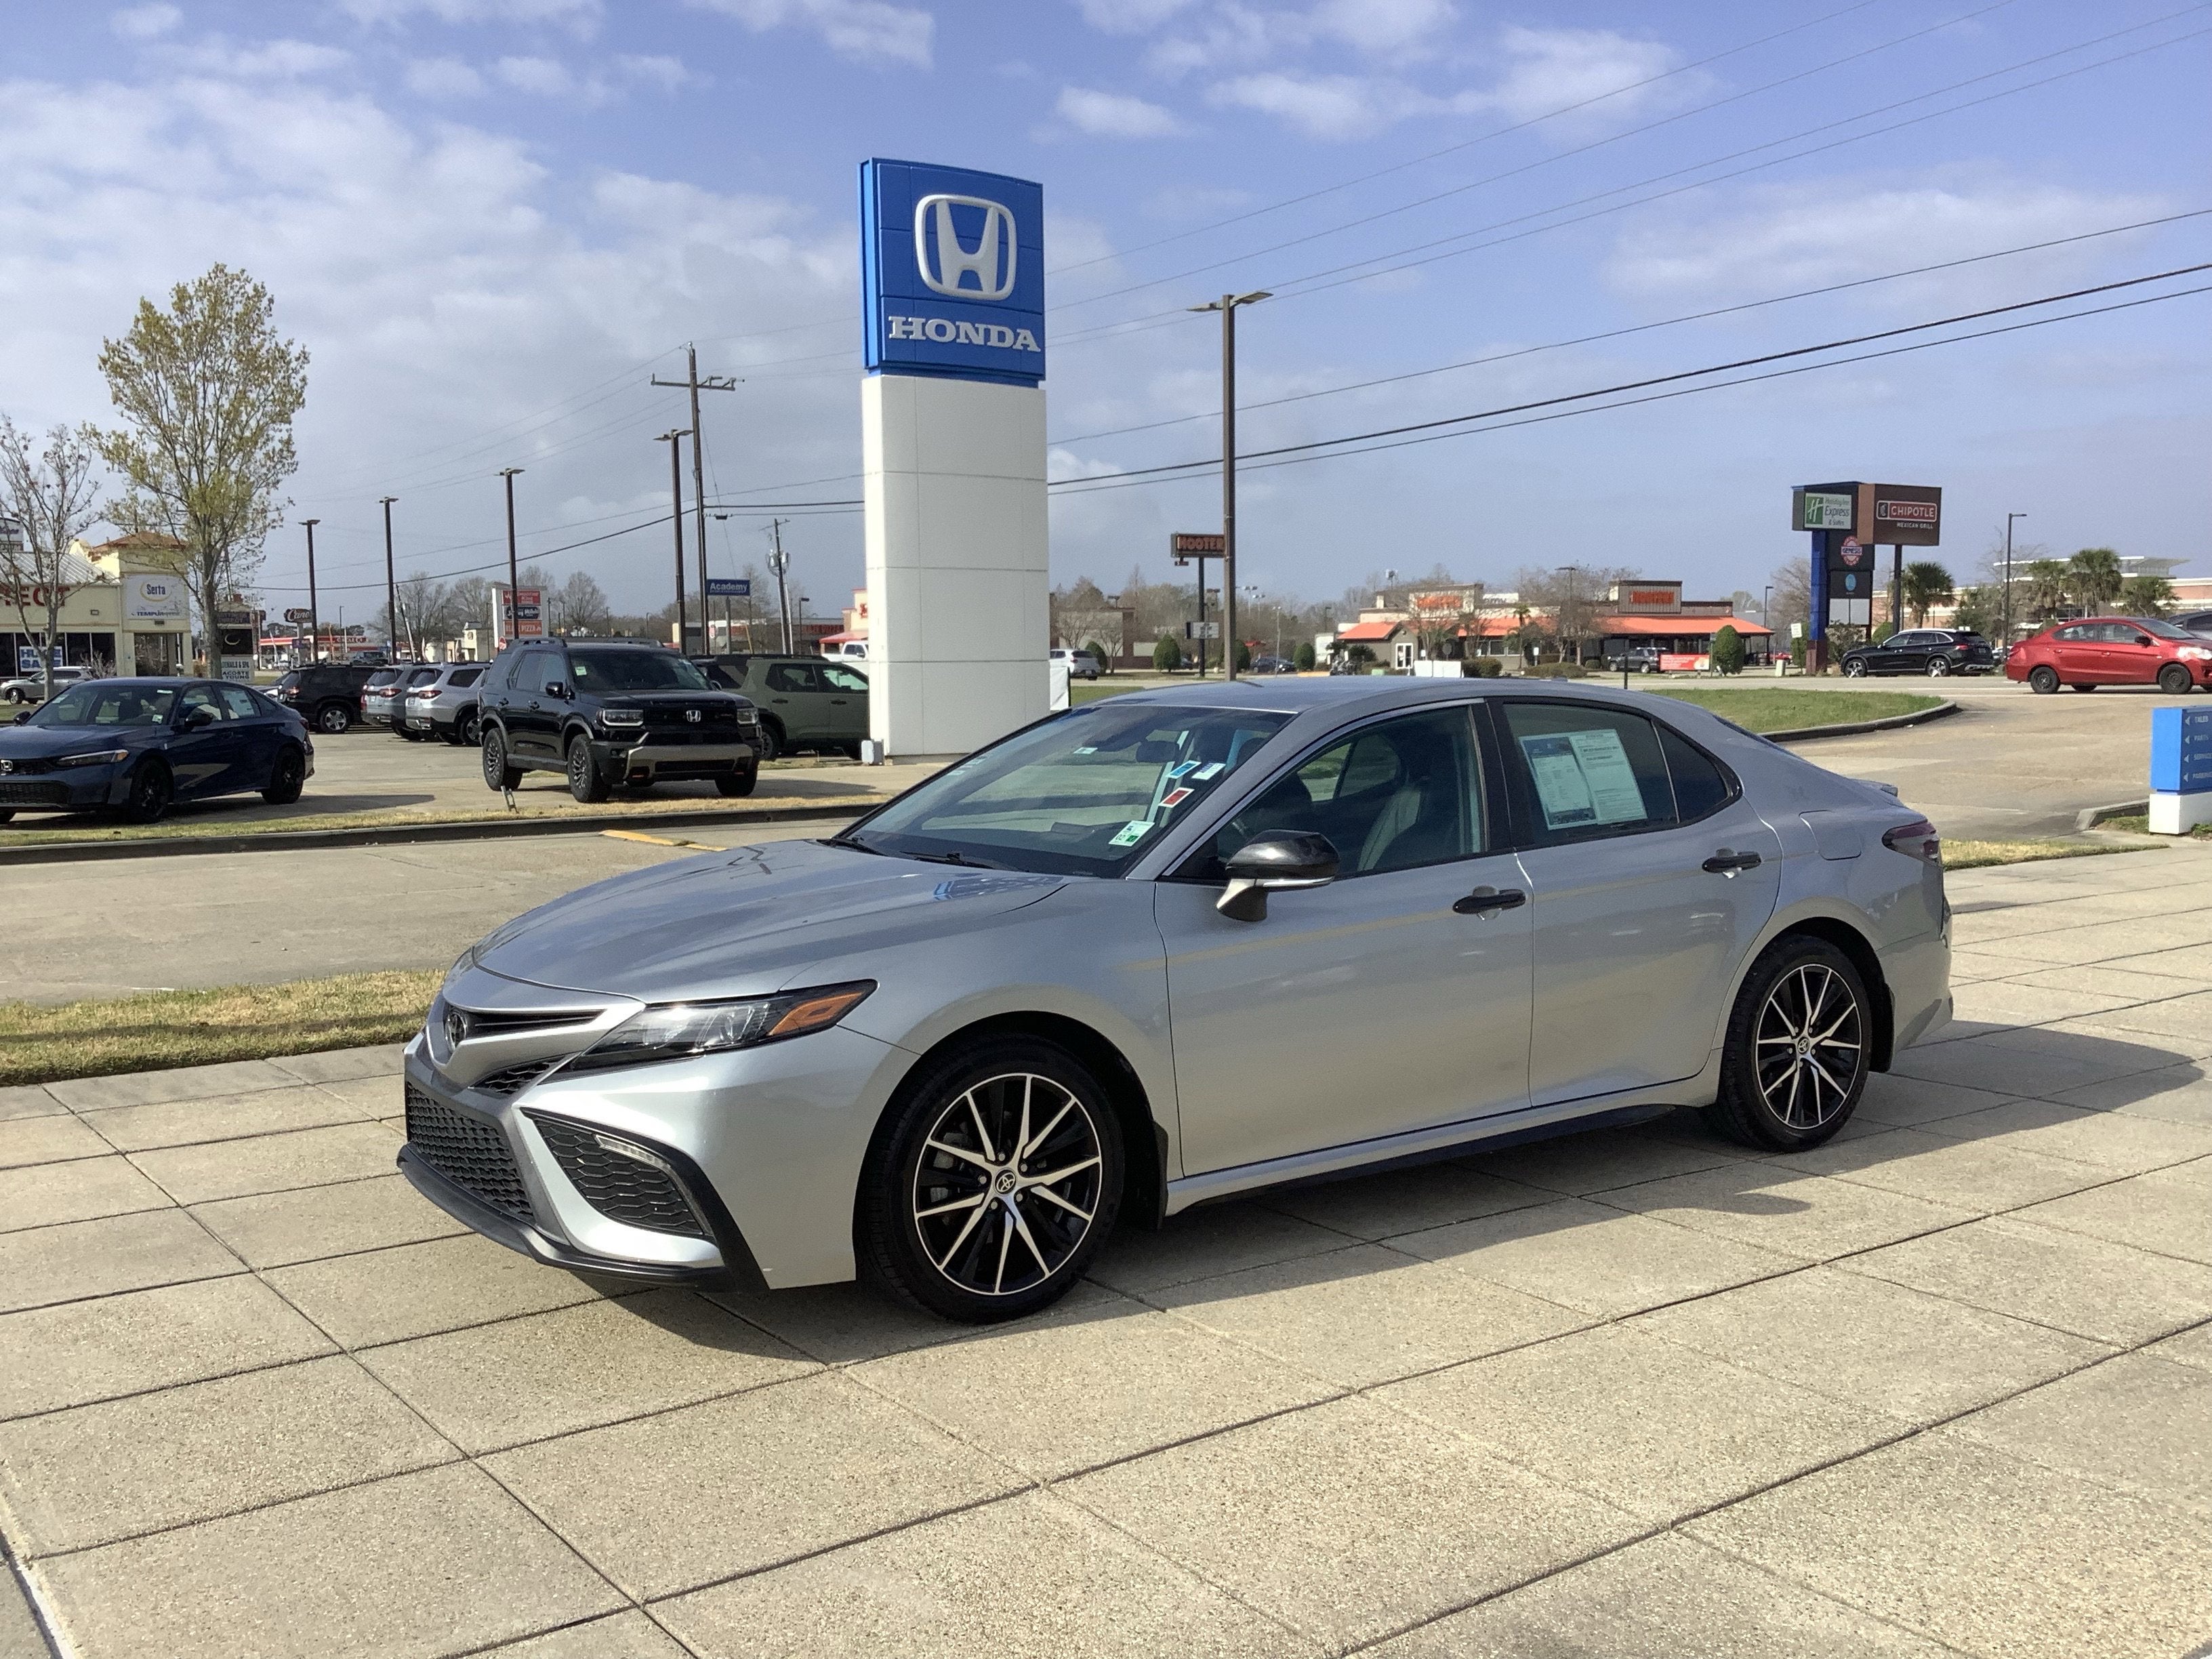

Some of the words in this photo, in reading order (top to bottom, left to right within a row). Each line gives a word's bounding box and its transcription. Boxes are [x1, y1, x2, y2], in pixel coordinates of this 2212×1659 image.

[888, 316, 1041, 352] HONDA
[1824, 505, 1849, 517] Express
[1891, 506, 1935, 518] CHIPOTLE
[1179, 536, 1225, 550] HOOTER
[146, 583, 166, 595] Serta
[710, 582, 747, 592] Academy
[287, 610, 310, 621] Cane
[20, 649, 61, 658] HUE
[21, 659, 62, 668] SAE
